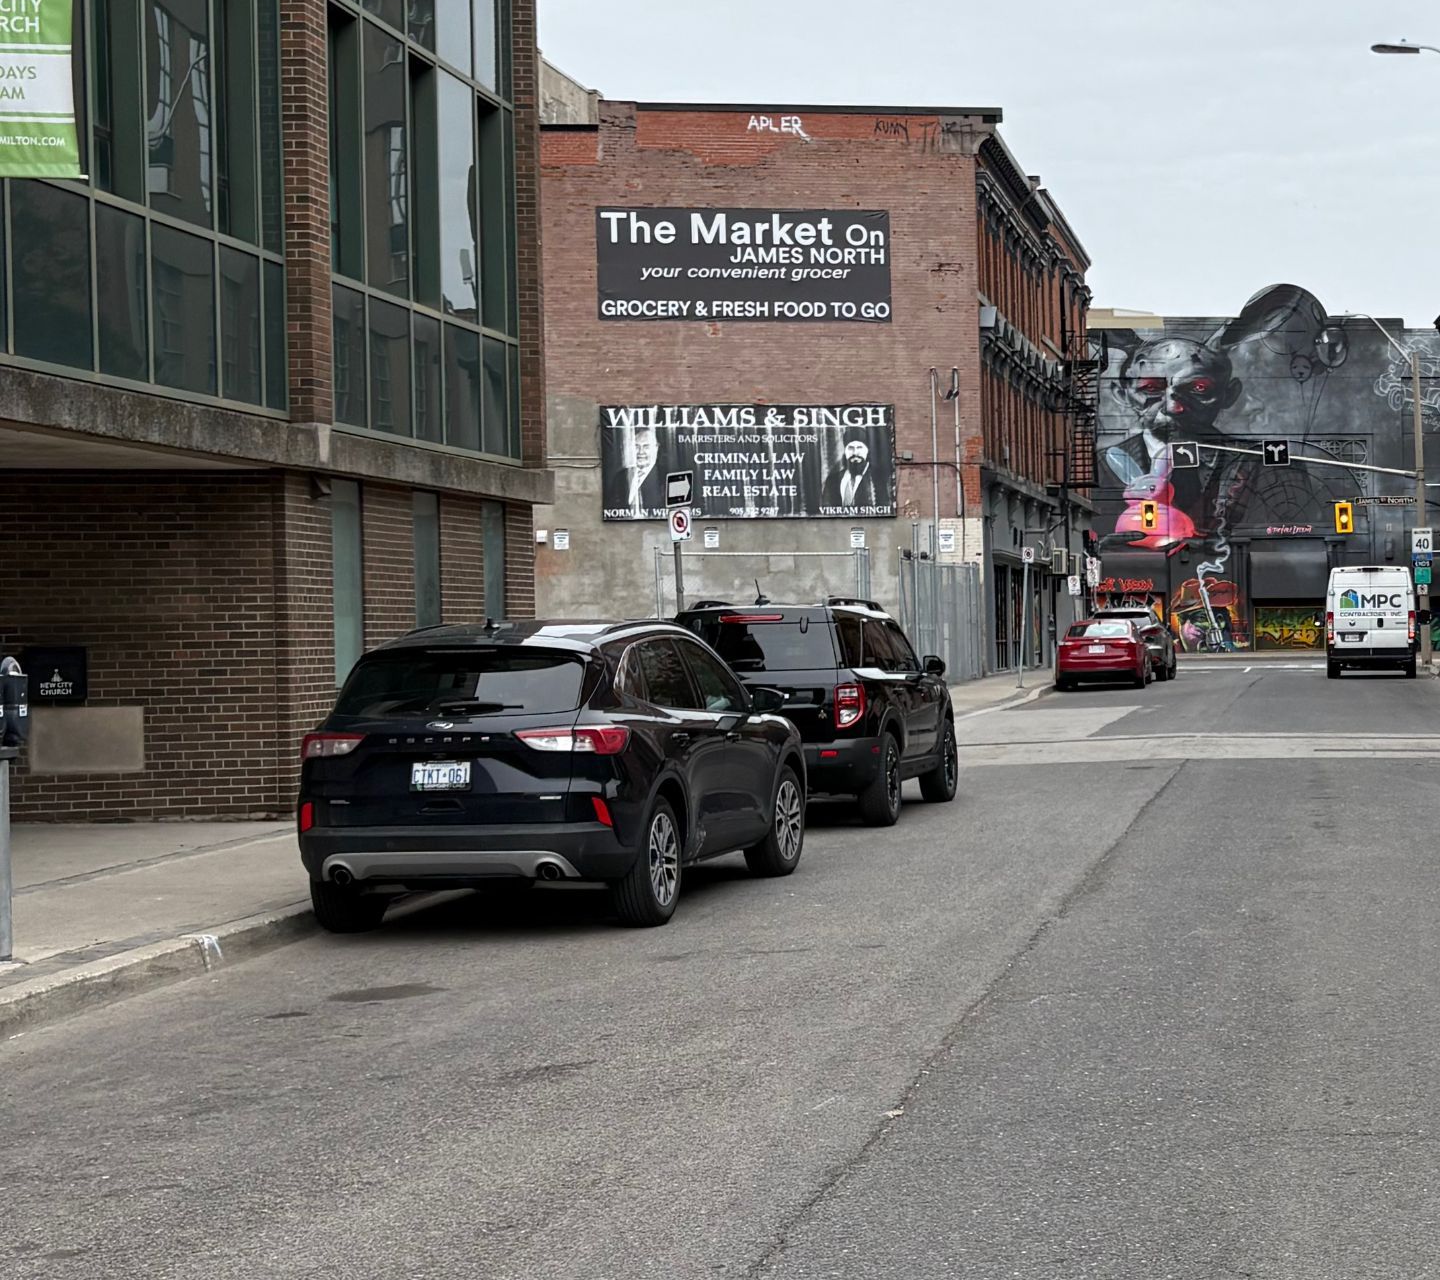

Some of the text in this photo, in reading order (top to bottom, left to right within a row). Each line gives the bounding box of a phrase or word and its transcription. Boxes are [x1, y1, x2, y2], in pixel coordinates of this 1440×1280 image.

[600, 212, 884, 246] The Market On
[729, 247, 885, 264] JAMES NORTH
[640, 266, 851, 281] your convenient grocer
[601, 300, 890, 318] GROCERY & FRESH FOOD TO GO
[606, 407, 887, 427] WILLIAMS & SINGH
[678, 434, 818, 443] BARRISTERS AND SOLICITORS
[694, 452, 805, 463] CRIMINAL LAW
[704, 469, 795, 480] FAMILY LAW
[702, 486, 797, 497] REAL ESTATE
[1388, 497, 1414, 505] NORTH
[652, 508, 701, 518] WILMS
[819, 506, 891, 515] VIKRAM SINGH
[1416, 538, 1430, 550] 40
[1361, 594, 1402, 608] MPC
